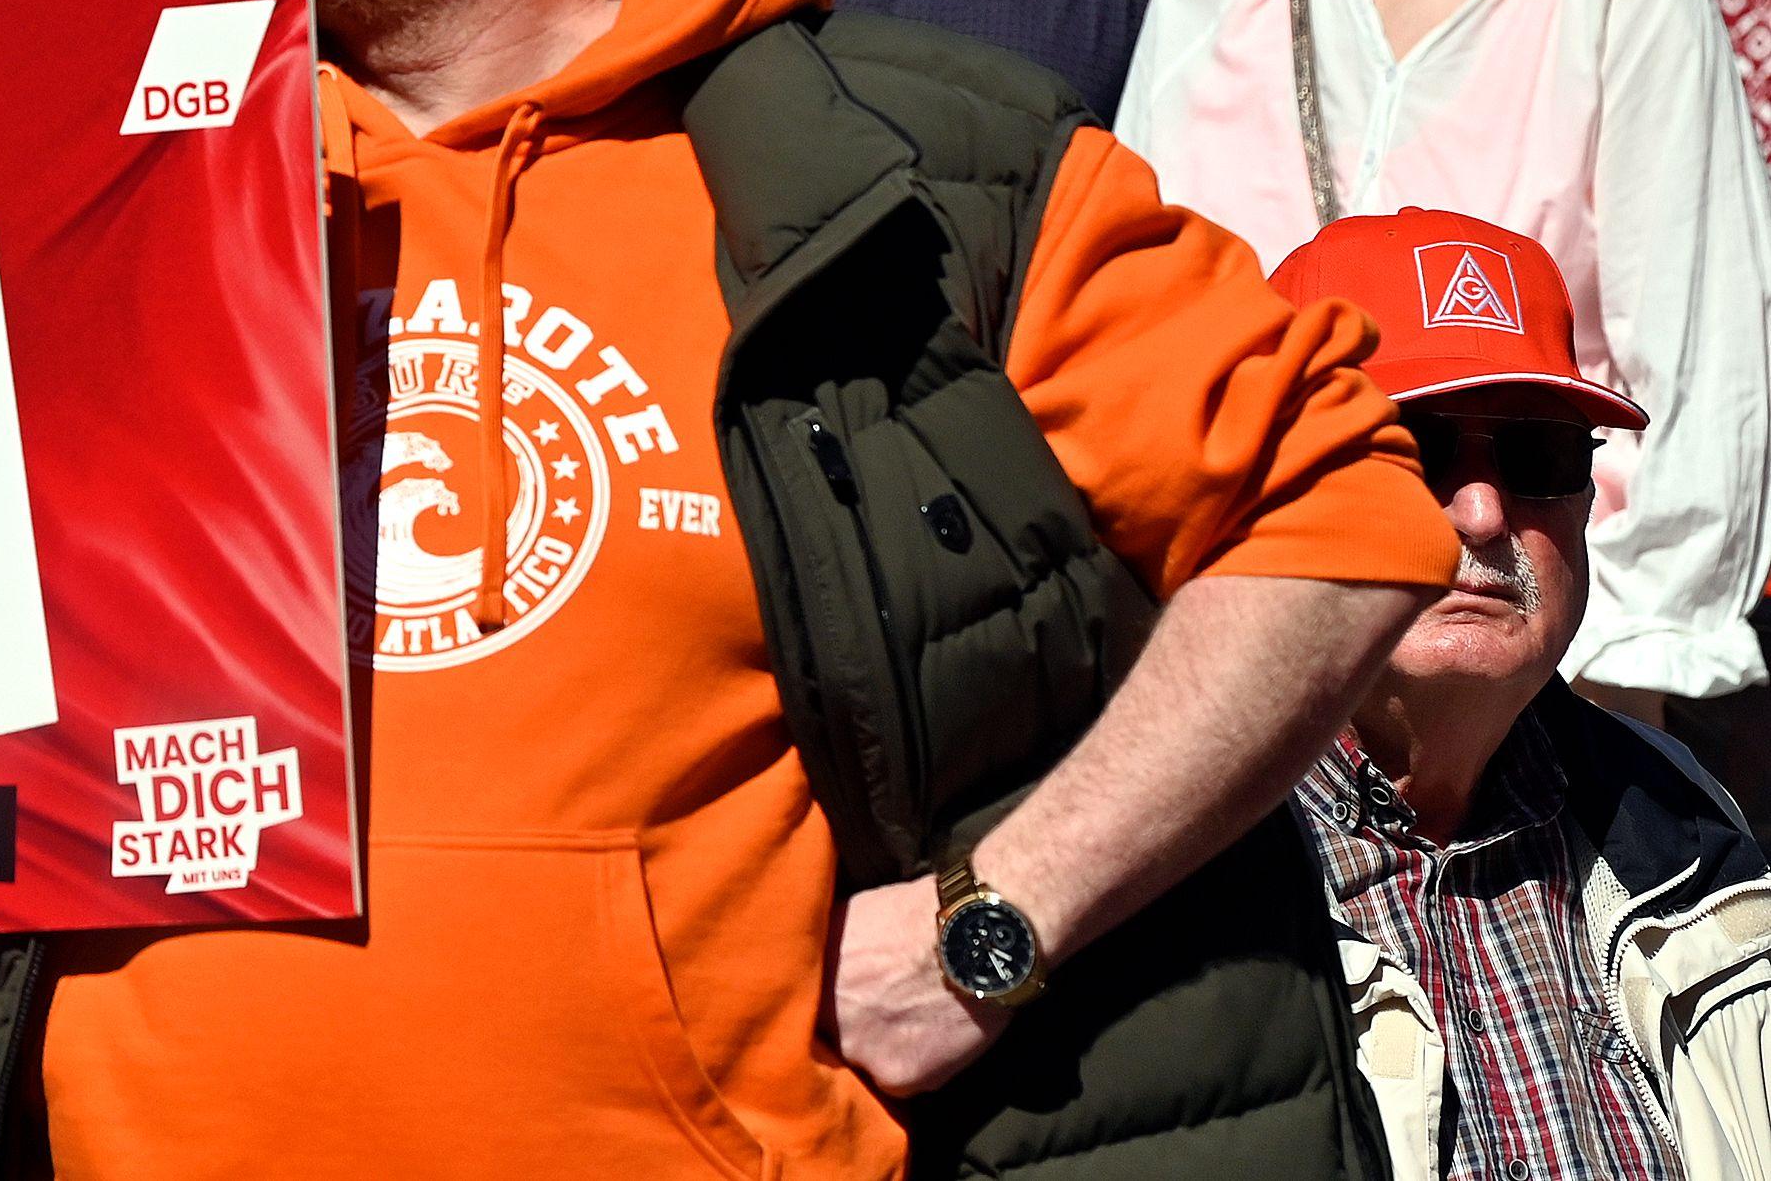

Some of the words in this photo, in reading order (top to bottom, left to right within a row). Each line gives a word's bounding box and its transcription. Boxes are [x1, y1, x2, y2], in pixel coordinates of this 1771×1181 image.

[144, 80, 230, 121] DGB
[638, 487, 721, 538] EVER
[124, 728, 245, 771] MACH
[152, 765, 289, 822] DICH
[119, 824, 245, 866] STARK
[182, 870, 208, 884] MIT
[212, 868, 241, 882] UNS
